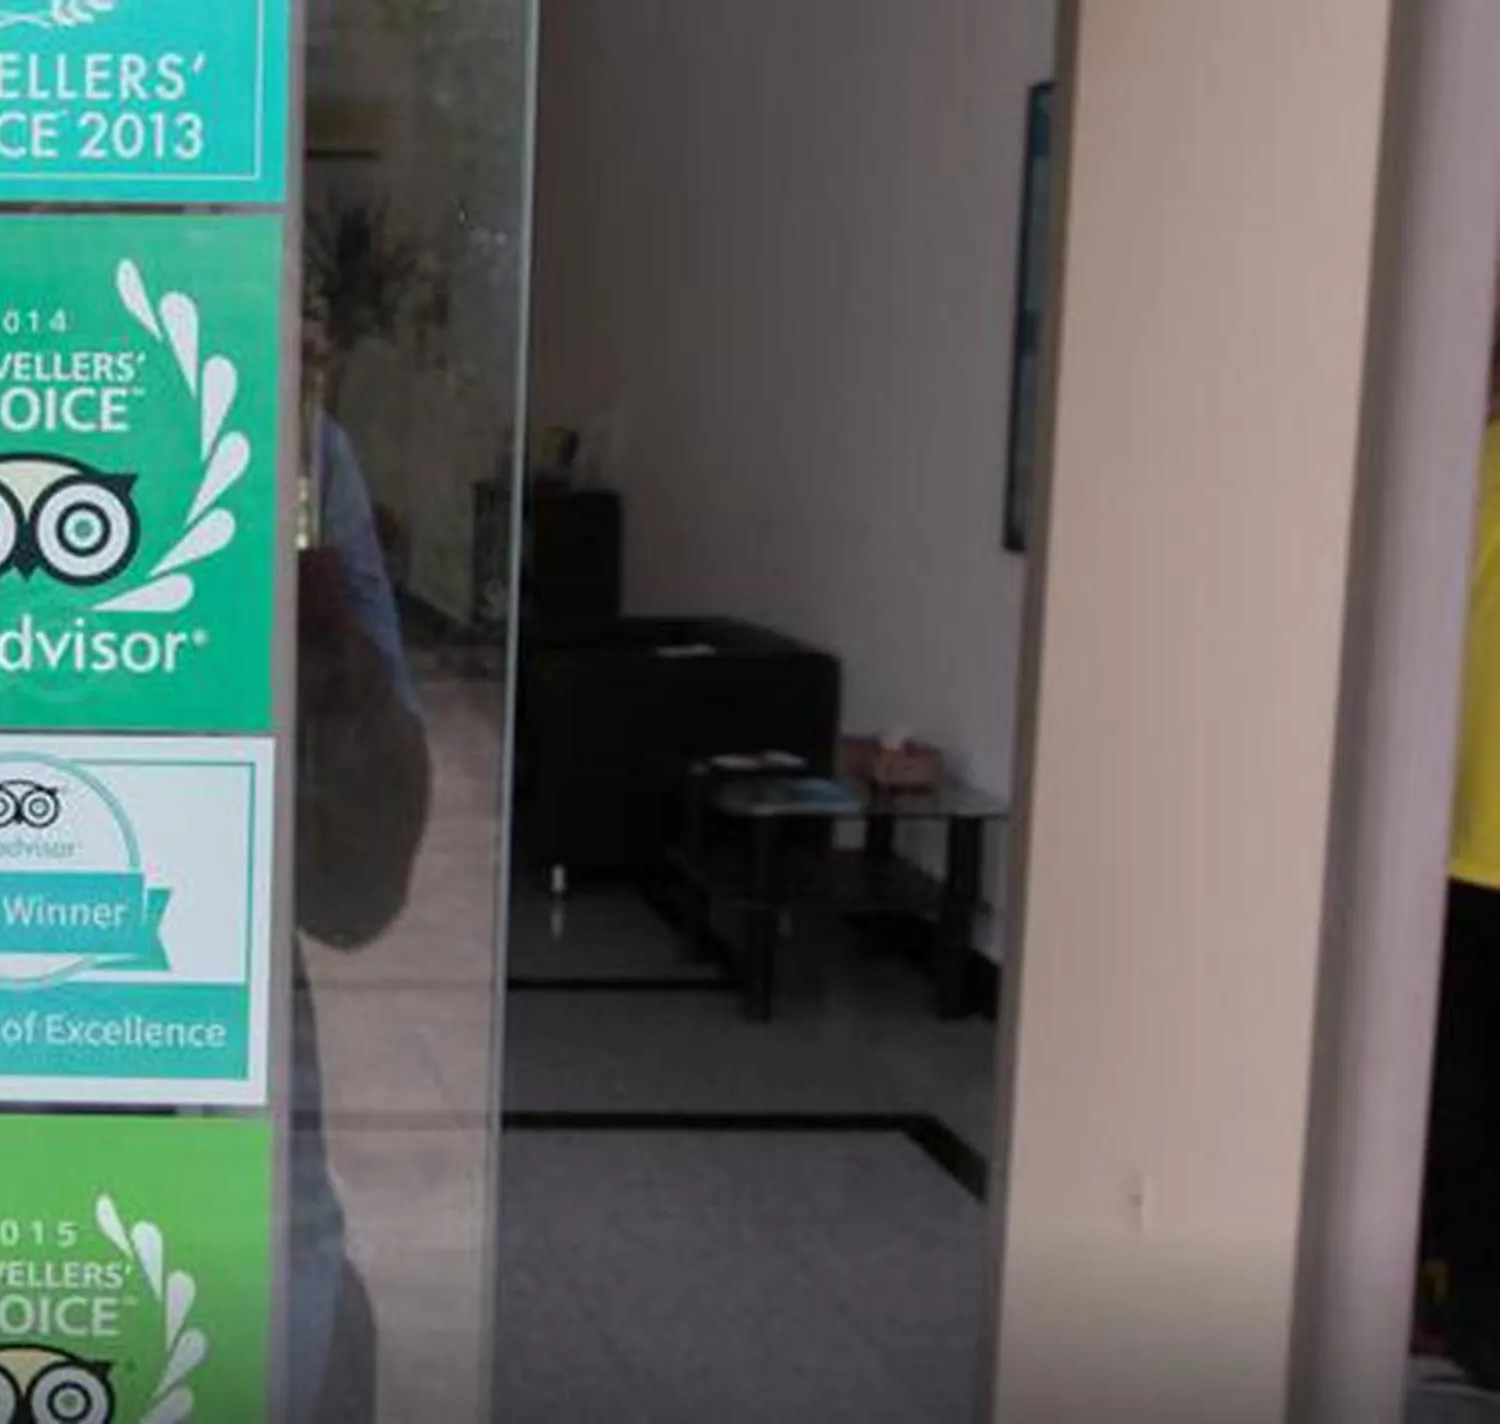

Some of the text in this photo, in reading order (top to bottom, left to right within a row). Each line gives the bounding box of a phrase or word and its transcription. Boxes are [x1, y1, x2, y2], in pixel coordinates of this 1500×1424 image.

[77, 111, 205, 160] 2013
[3, 894, 129, 929] Winner
[1, 1010, 37, 1045] of
[46, 1013, 228, 1049] Excellence
